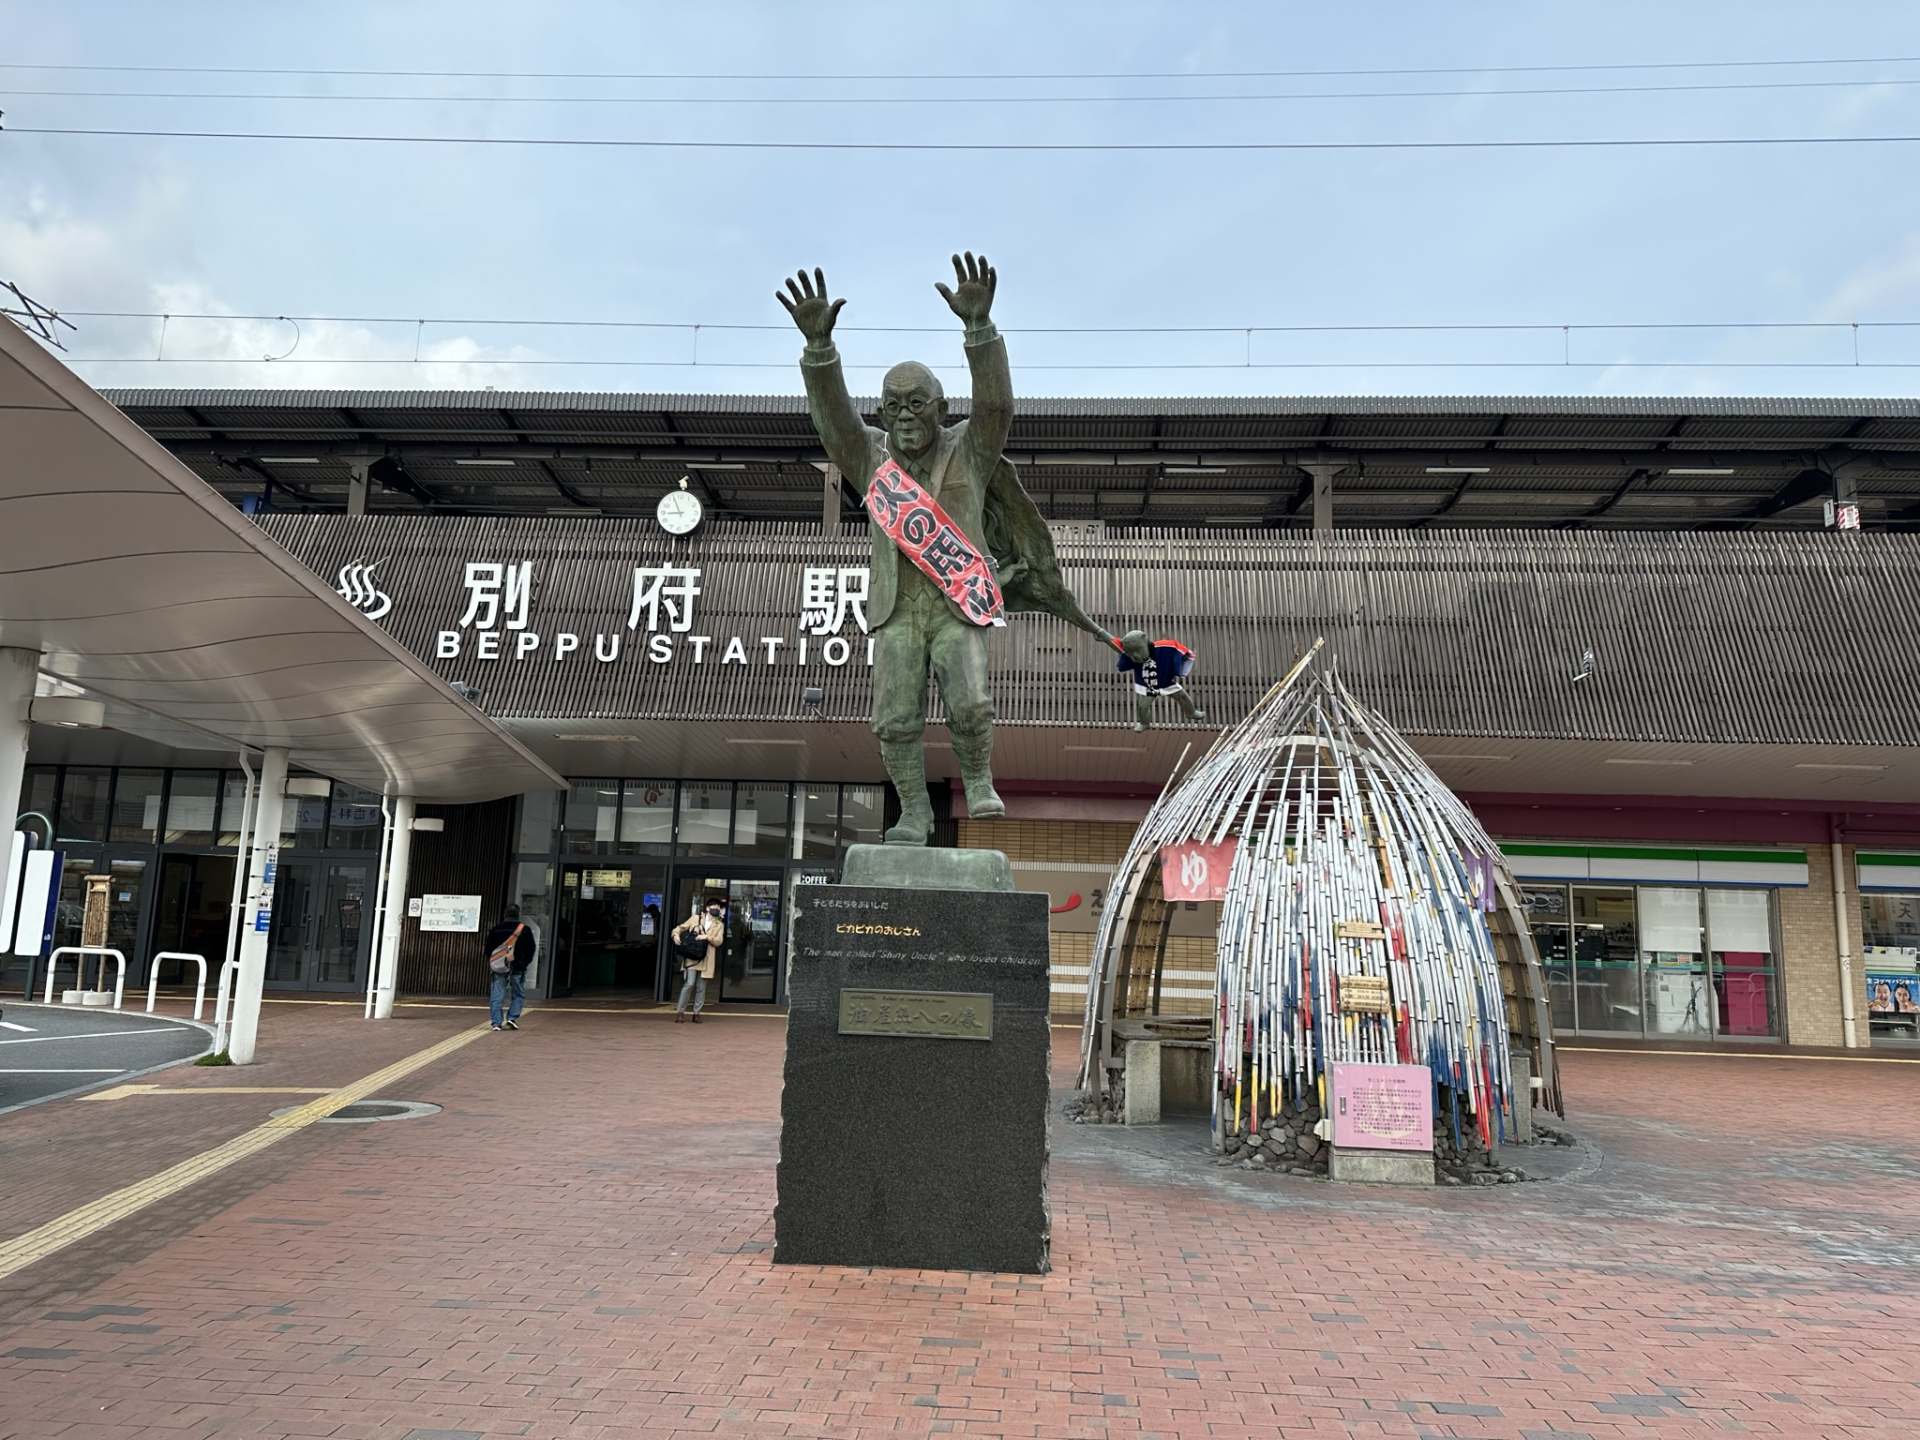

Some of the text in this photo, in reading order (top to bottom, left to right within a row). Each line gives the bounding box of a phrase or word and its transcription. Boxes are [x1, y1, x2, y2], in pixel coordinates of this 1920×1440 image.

[874, 471, 996, 621] 火の用心
[459, 560, 870, 636] 別府駅
[437, 631, 620, 663] BEPPU
[1181, 850, 1207, 893] ゆ
[803, 947, 820, 957] The
